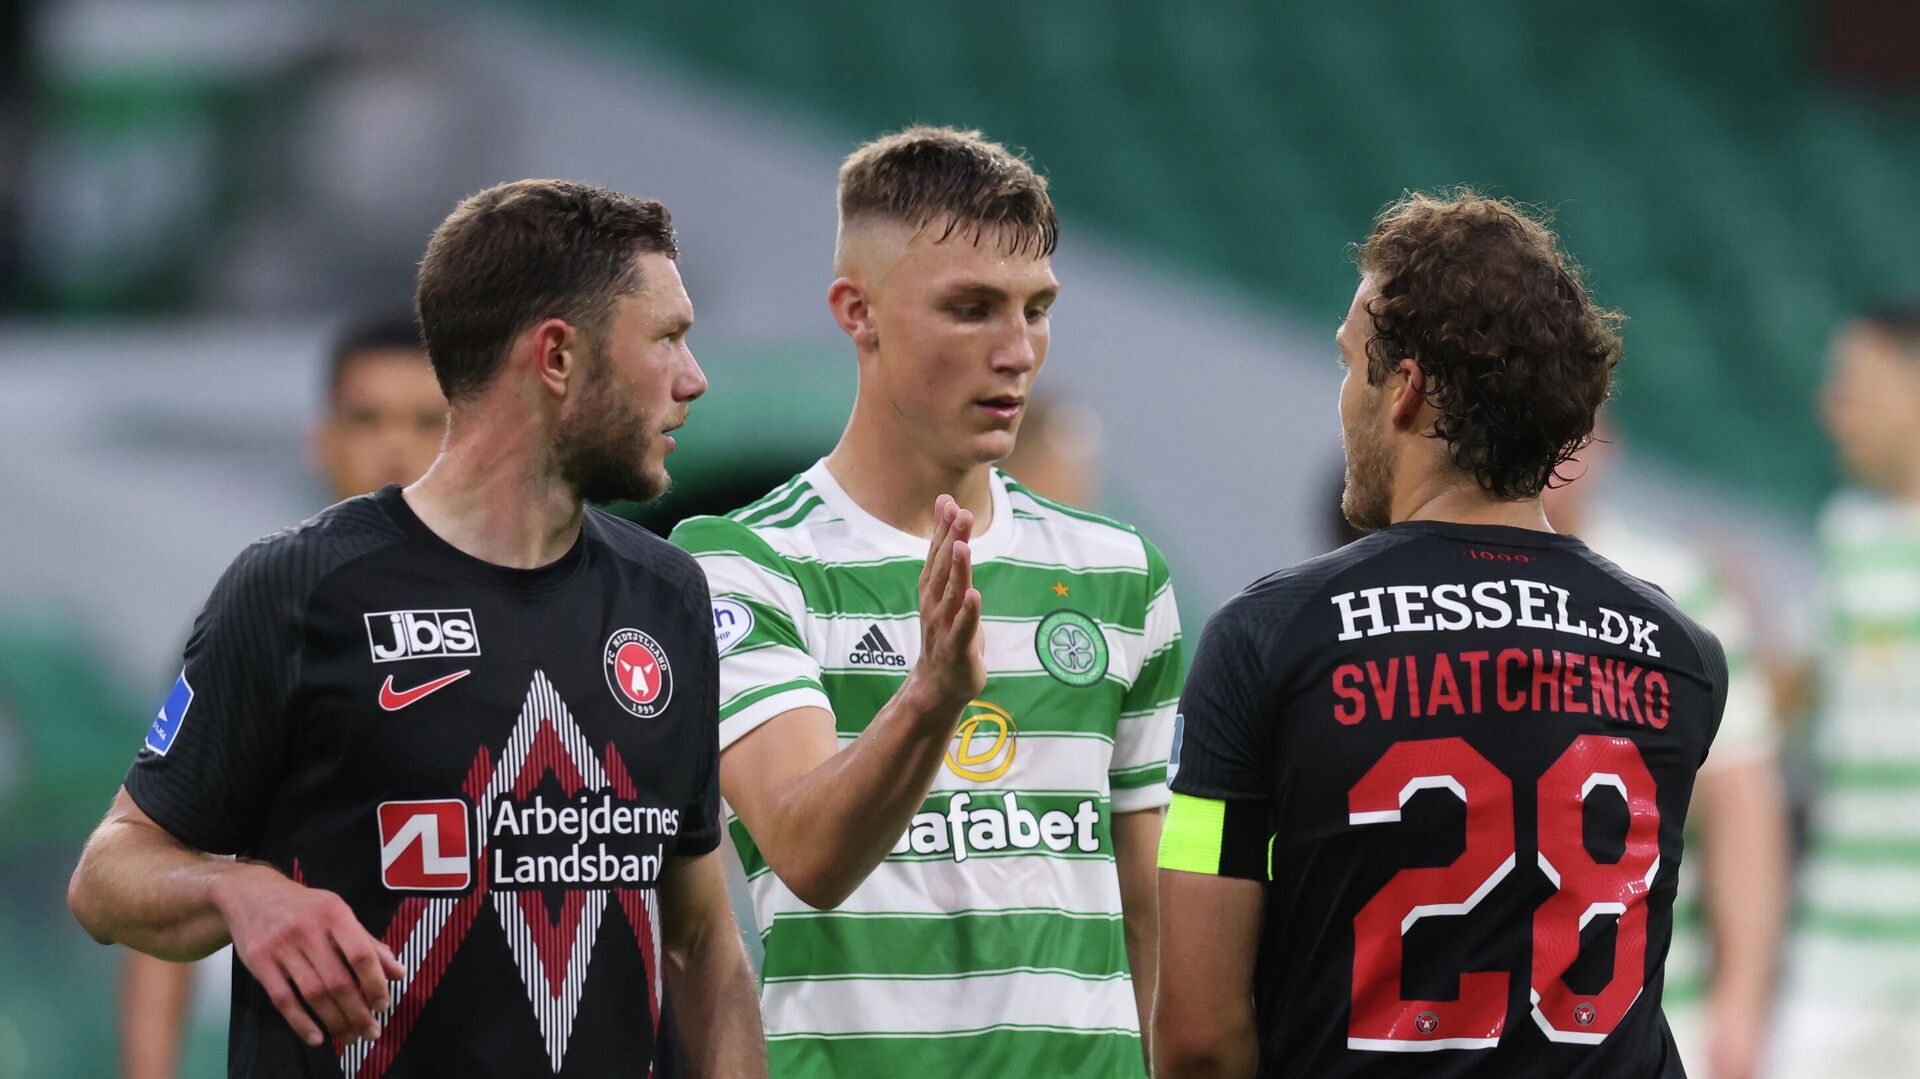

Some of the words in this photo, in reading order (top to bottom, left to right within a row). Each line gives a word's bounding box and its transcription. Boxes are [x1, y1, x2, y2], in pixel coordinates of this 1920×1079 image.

[374, 613, 475, 659] jbs
[1331, 579, 1661, 658] HESSEL.DK
[612, 632, 668, 671] MIDTJYLLAND
[849, 650, 906, 667] adidas
[632, 703, 655, 715] 1999
[1332, 648, 1670, 729] SVIATCHENKO
[493, 795, 679, 845] Arbejdernes
[1347, 734, 1661, 1053] 28
